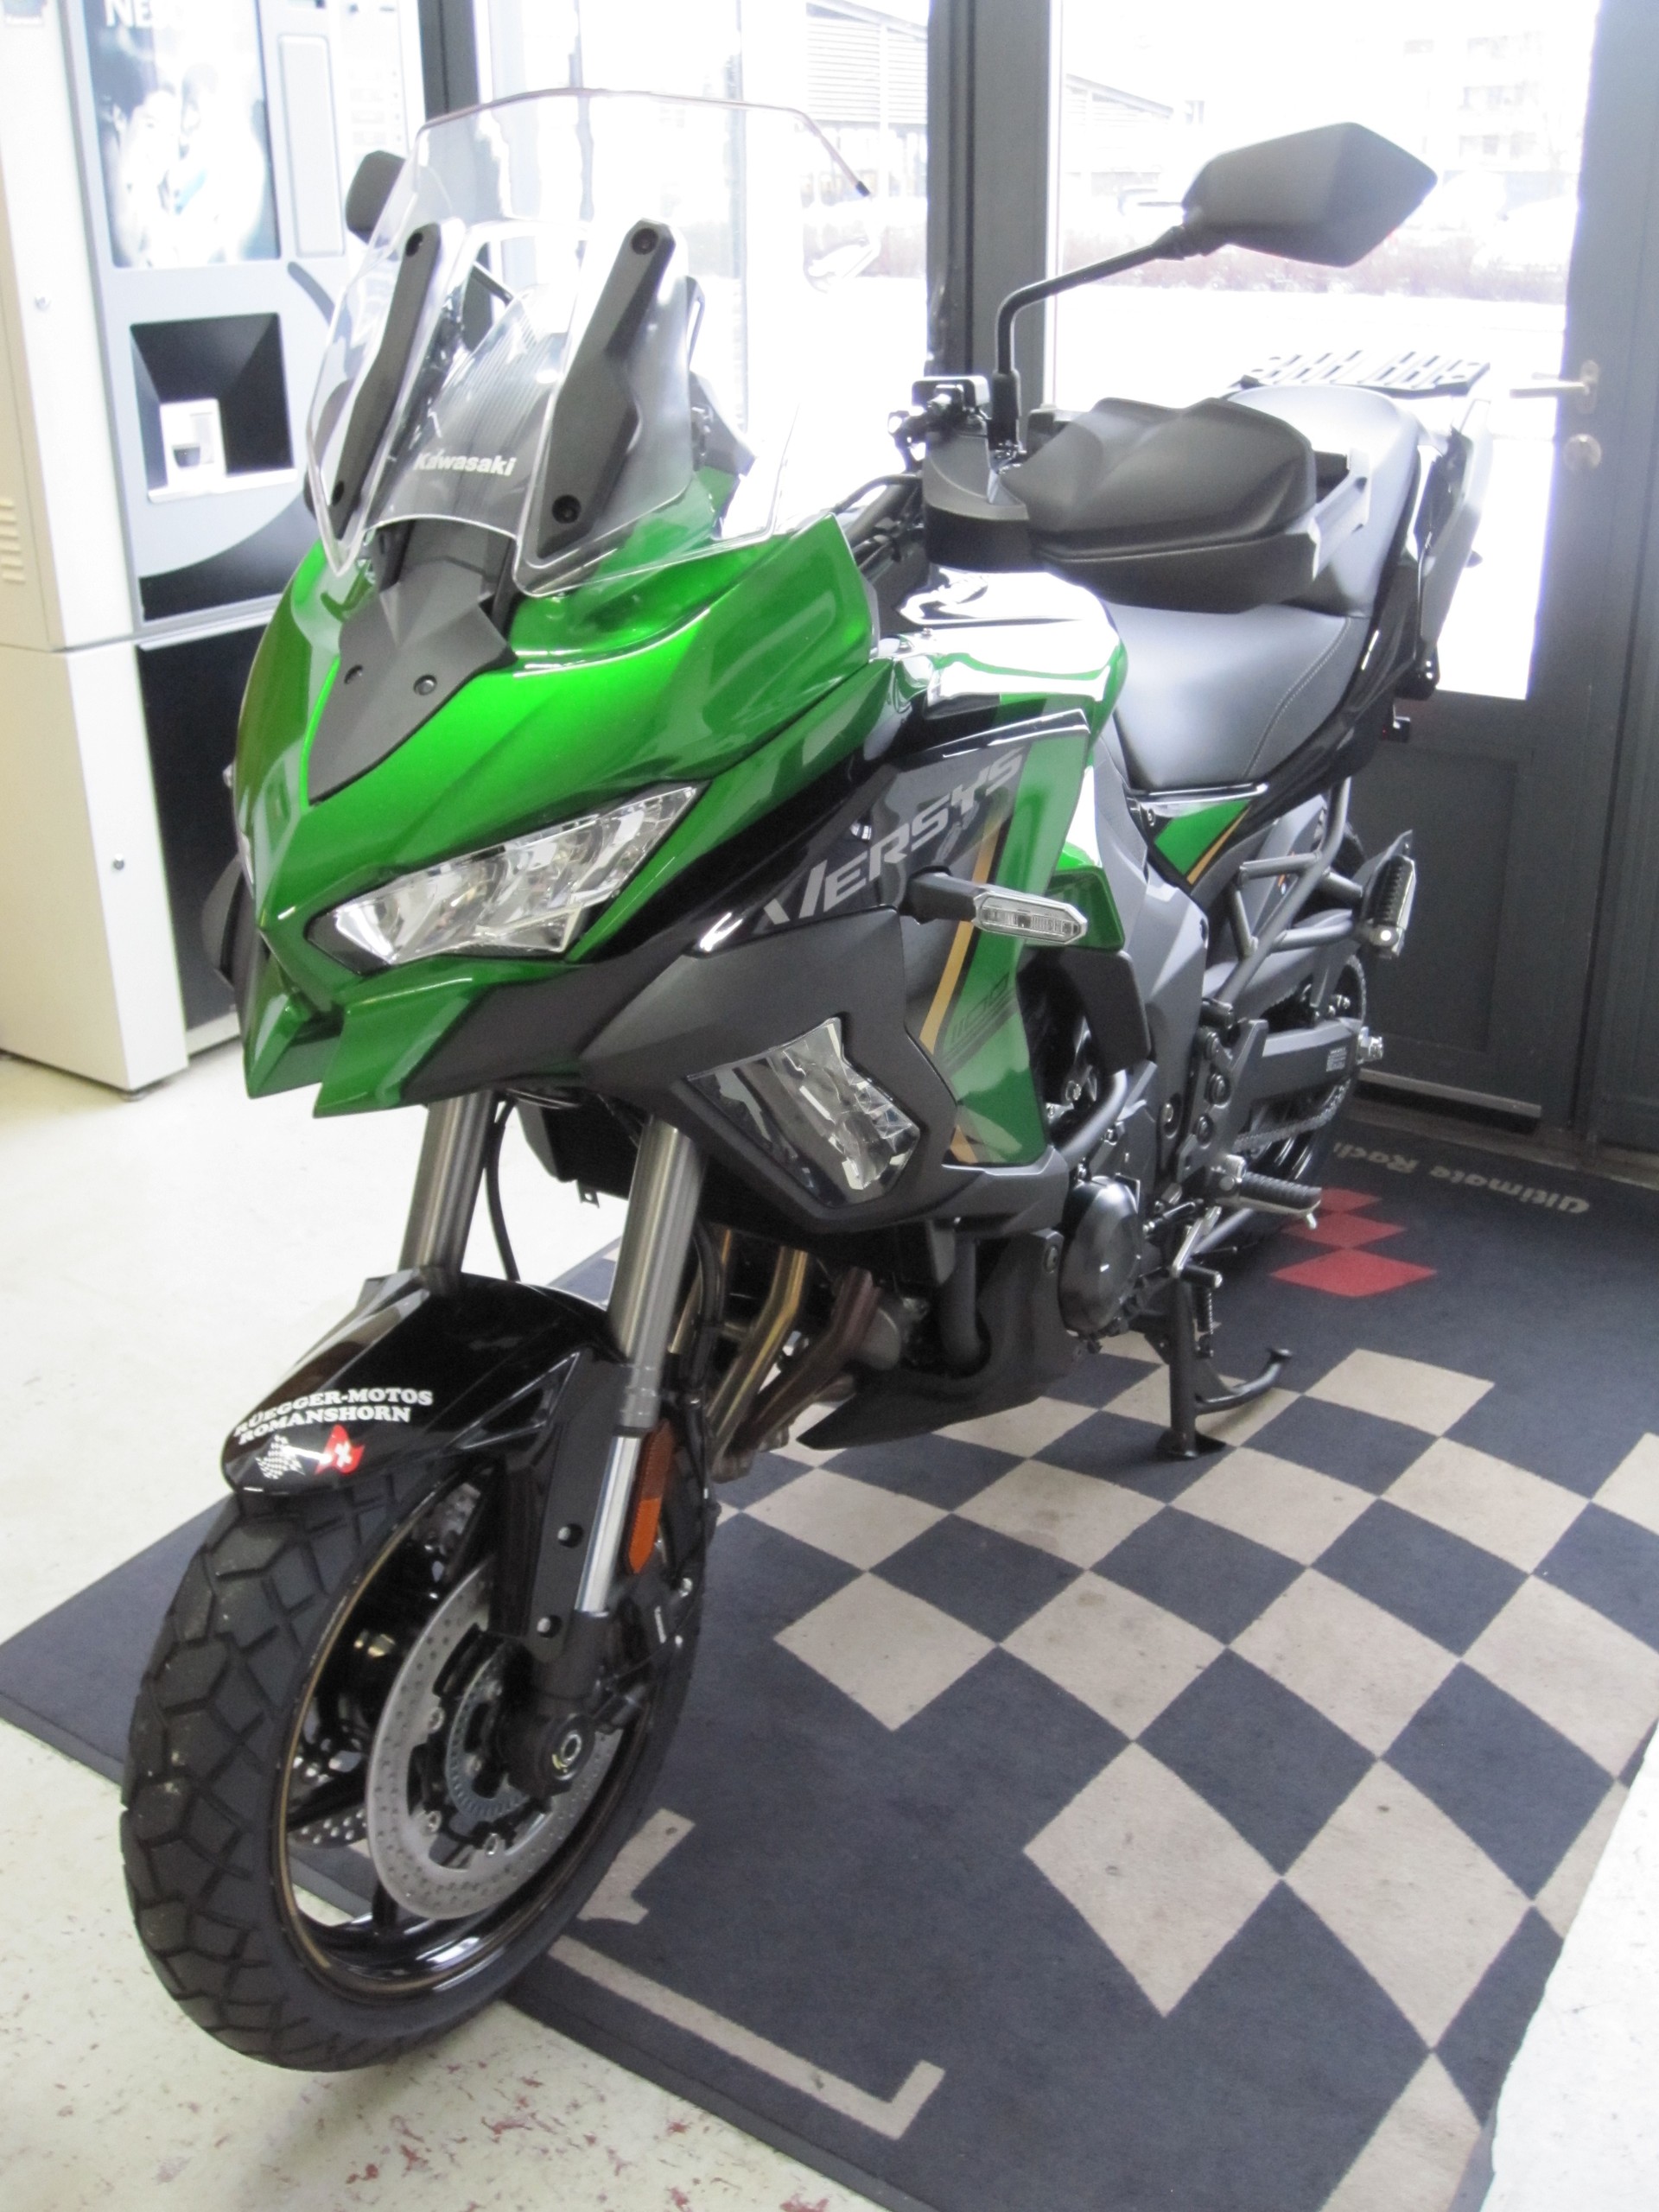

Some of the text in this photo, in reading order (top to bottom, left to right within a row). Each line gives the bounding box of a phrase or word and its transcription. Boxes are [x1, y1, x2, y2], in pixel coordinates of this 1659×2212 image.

[414, 448, 518, 476] Kawasaki
[764, 746, 1025, 925] VERSYS
[1430, 1166, 1590, 1213] Ultimate
[238, 1405, 411, 1445] ROMANSHORN
